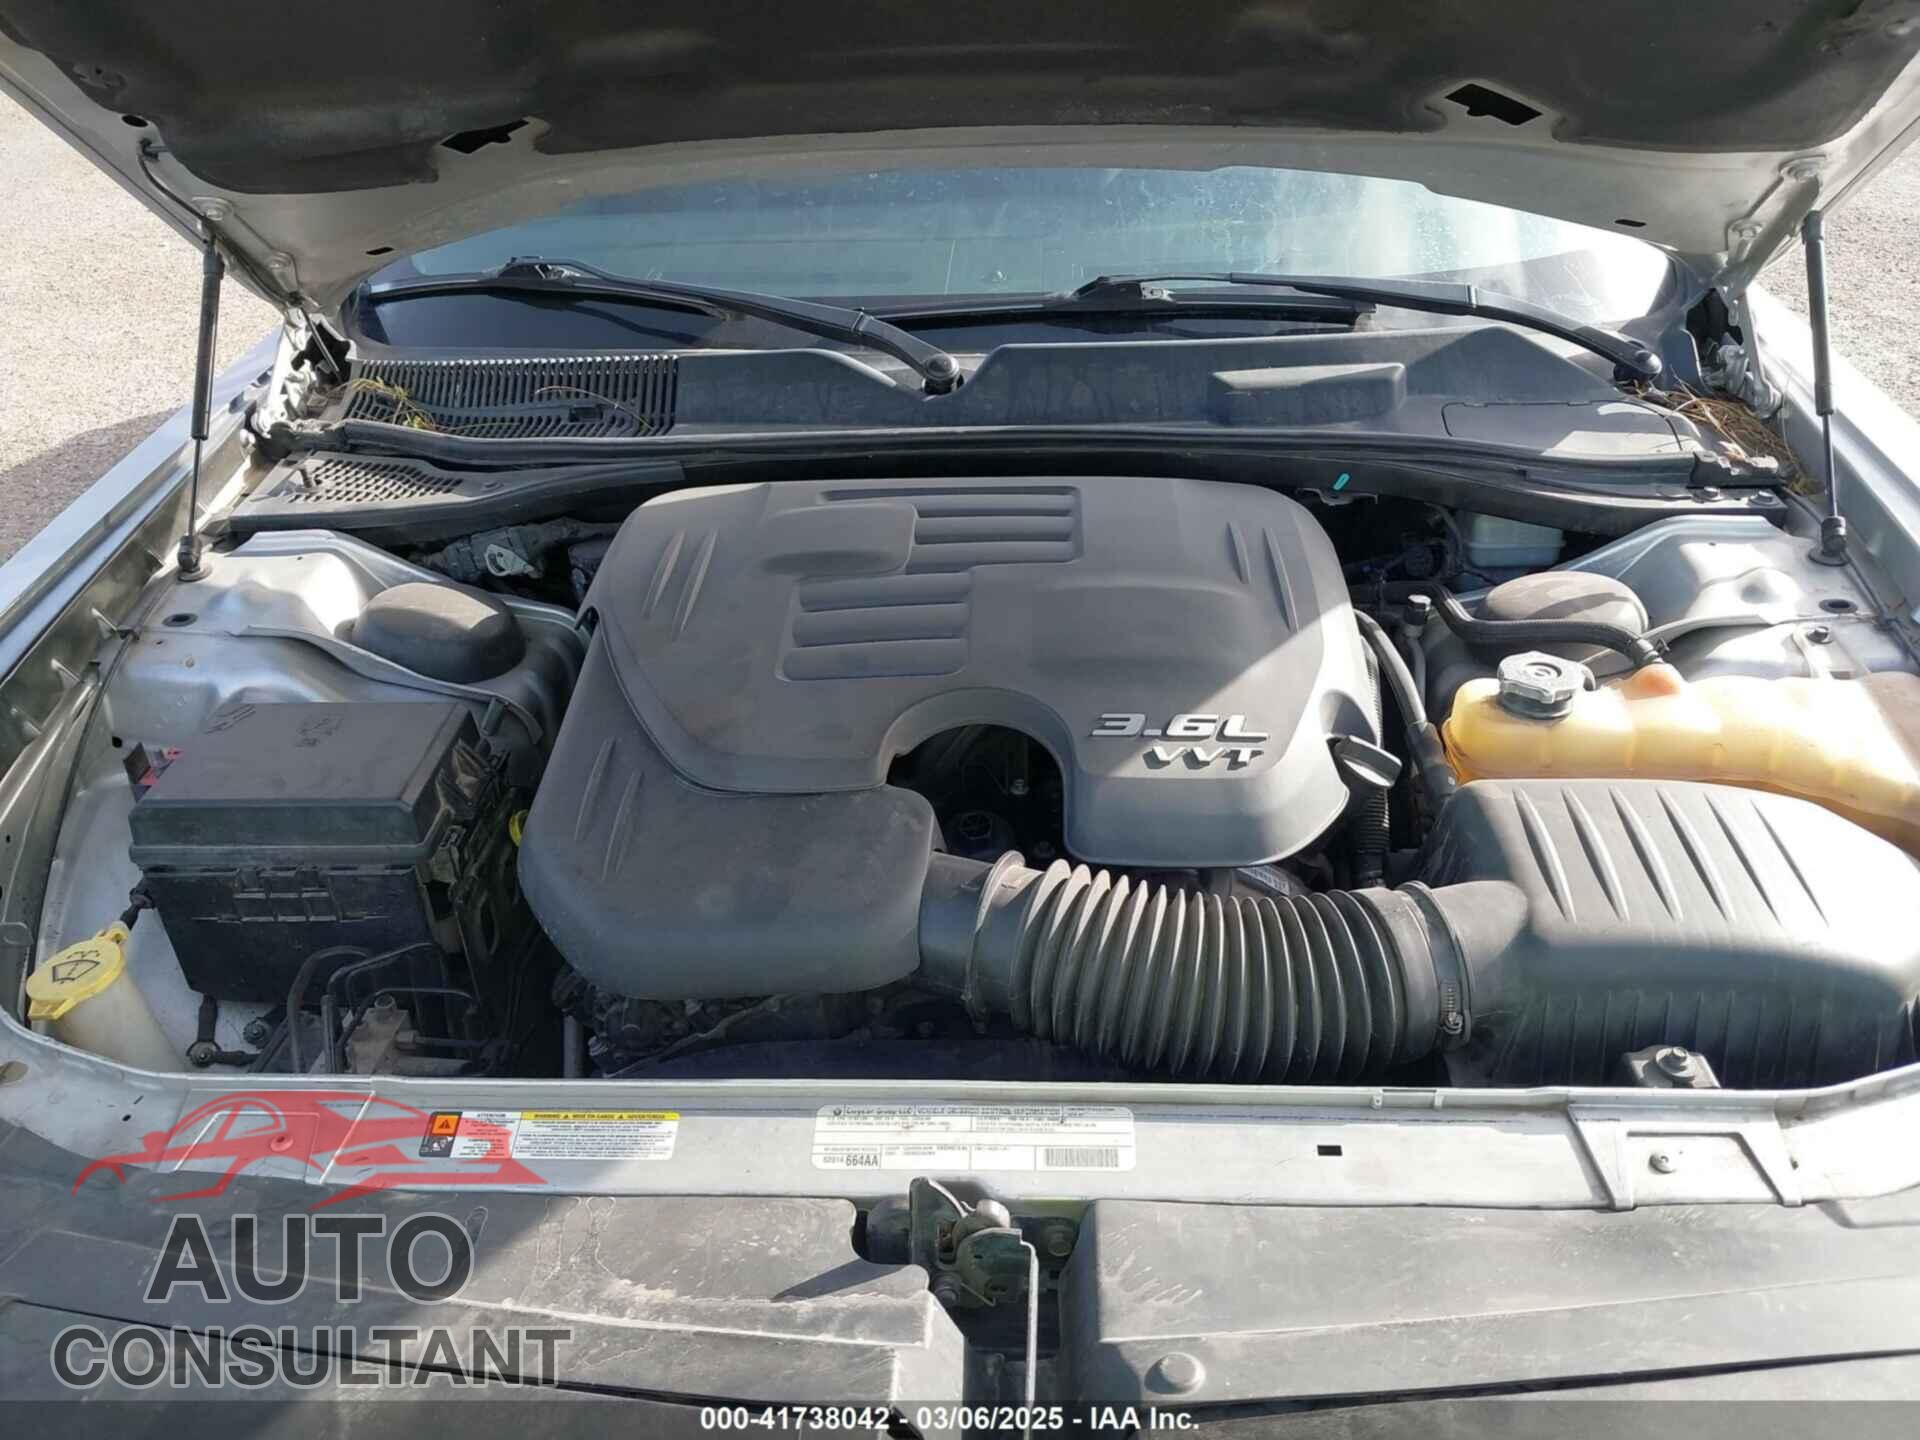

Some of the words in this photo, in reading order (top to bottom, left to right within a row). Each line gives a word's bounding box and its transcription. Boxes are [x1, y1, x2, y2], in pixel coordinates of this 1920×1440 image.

[1089, 713, 1268, 742] 3.6L
[1143, 746, 1264, 770] VVT
[846, 1154, 878, 1166] 664AA
